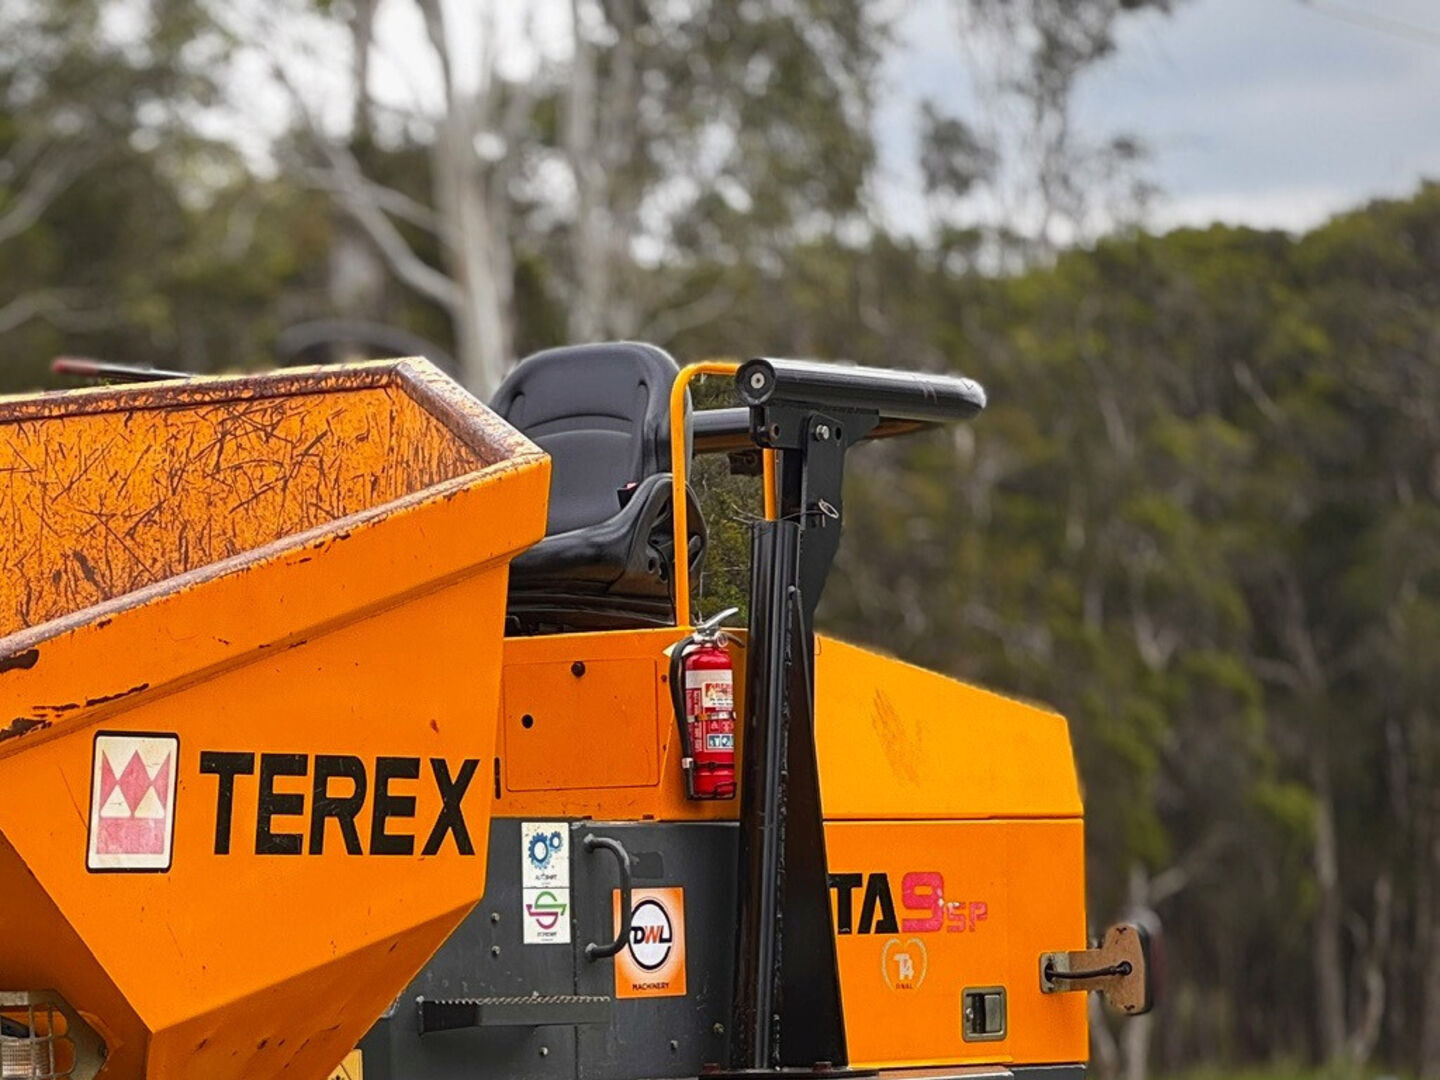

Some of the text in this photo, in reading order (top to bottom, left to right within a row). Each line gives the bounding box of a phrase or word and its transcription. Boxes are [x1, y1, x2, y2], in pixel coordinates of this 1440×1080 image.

[199, 751, 480, 856] TEREX
[631, 925, 672, 944] DWL
[632, 982, 669, 991] MACHINERY
